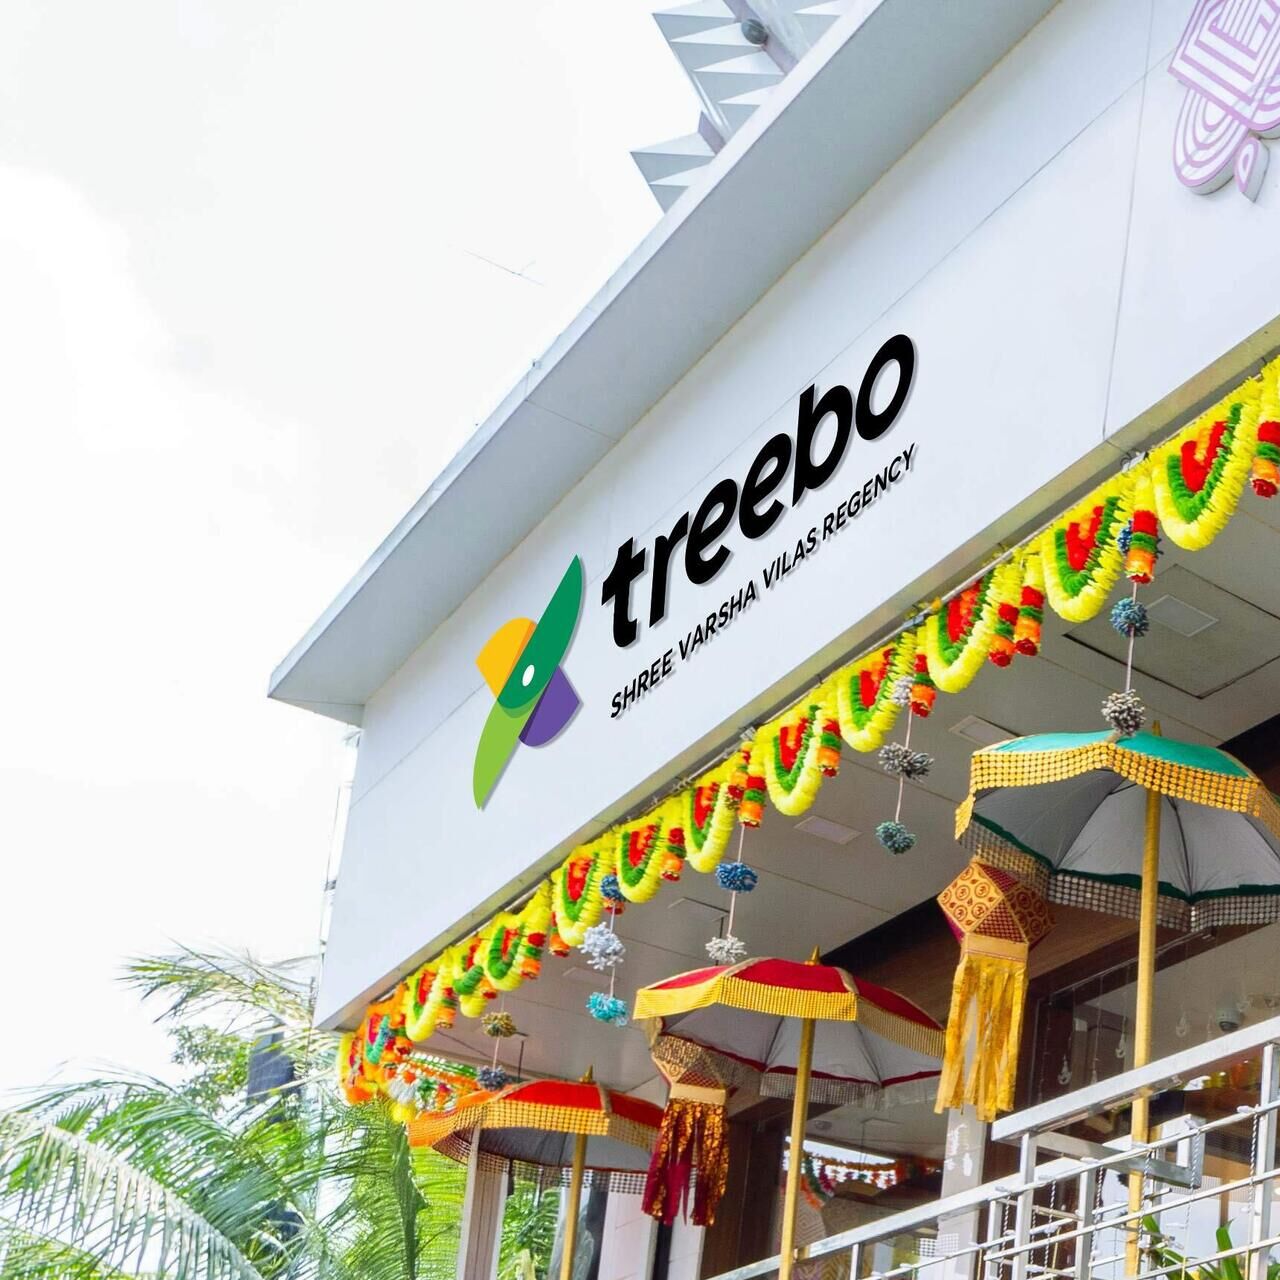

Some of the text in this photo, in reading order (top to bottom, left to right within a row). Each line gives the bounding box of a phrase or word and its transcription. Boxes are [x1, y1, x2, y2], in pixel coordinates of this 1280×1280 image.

[601, 334, 915, 648] treebo
[610, 443, 916, 718] SHREE VARSHA VILAS REGENCY
